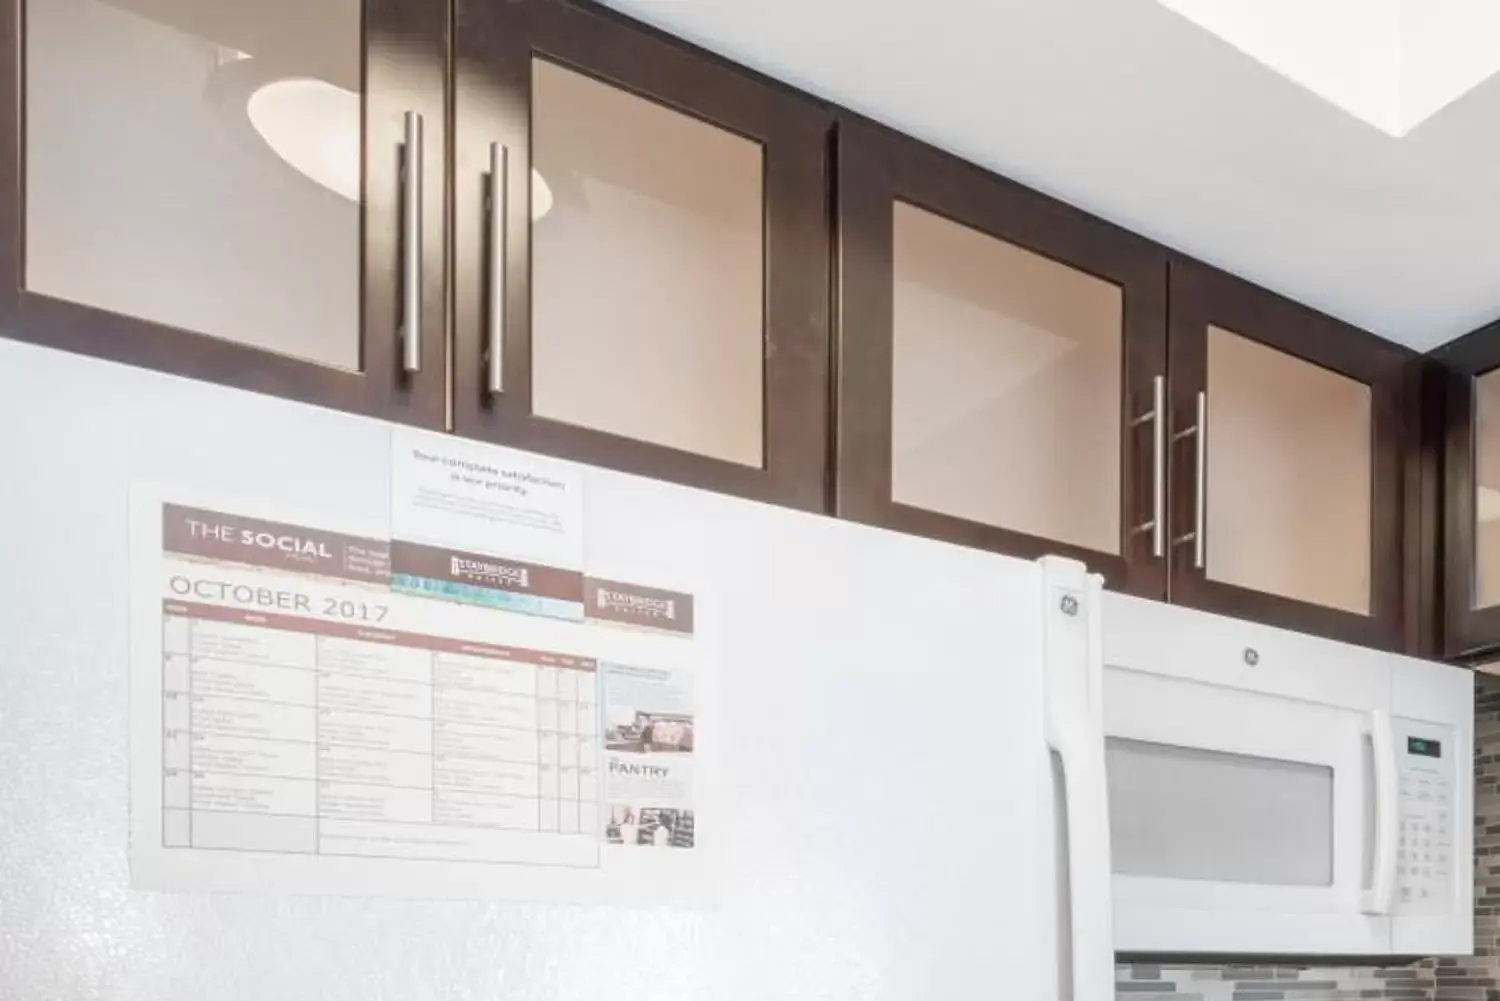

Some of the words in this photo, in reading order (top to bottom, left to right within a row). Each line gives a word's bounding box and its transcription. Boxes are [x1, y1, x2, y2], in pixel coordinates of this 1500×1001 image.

[185, 517, 236, 544] THE
[240, 529, 333, 559] SOCIAL
[169, 575, 312, 612] OCTOBER
[322, 597, 390, 623] 2017
[608, 760, 670, 777] PANTRY
